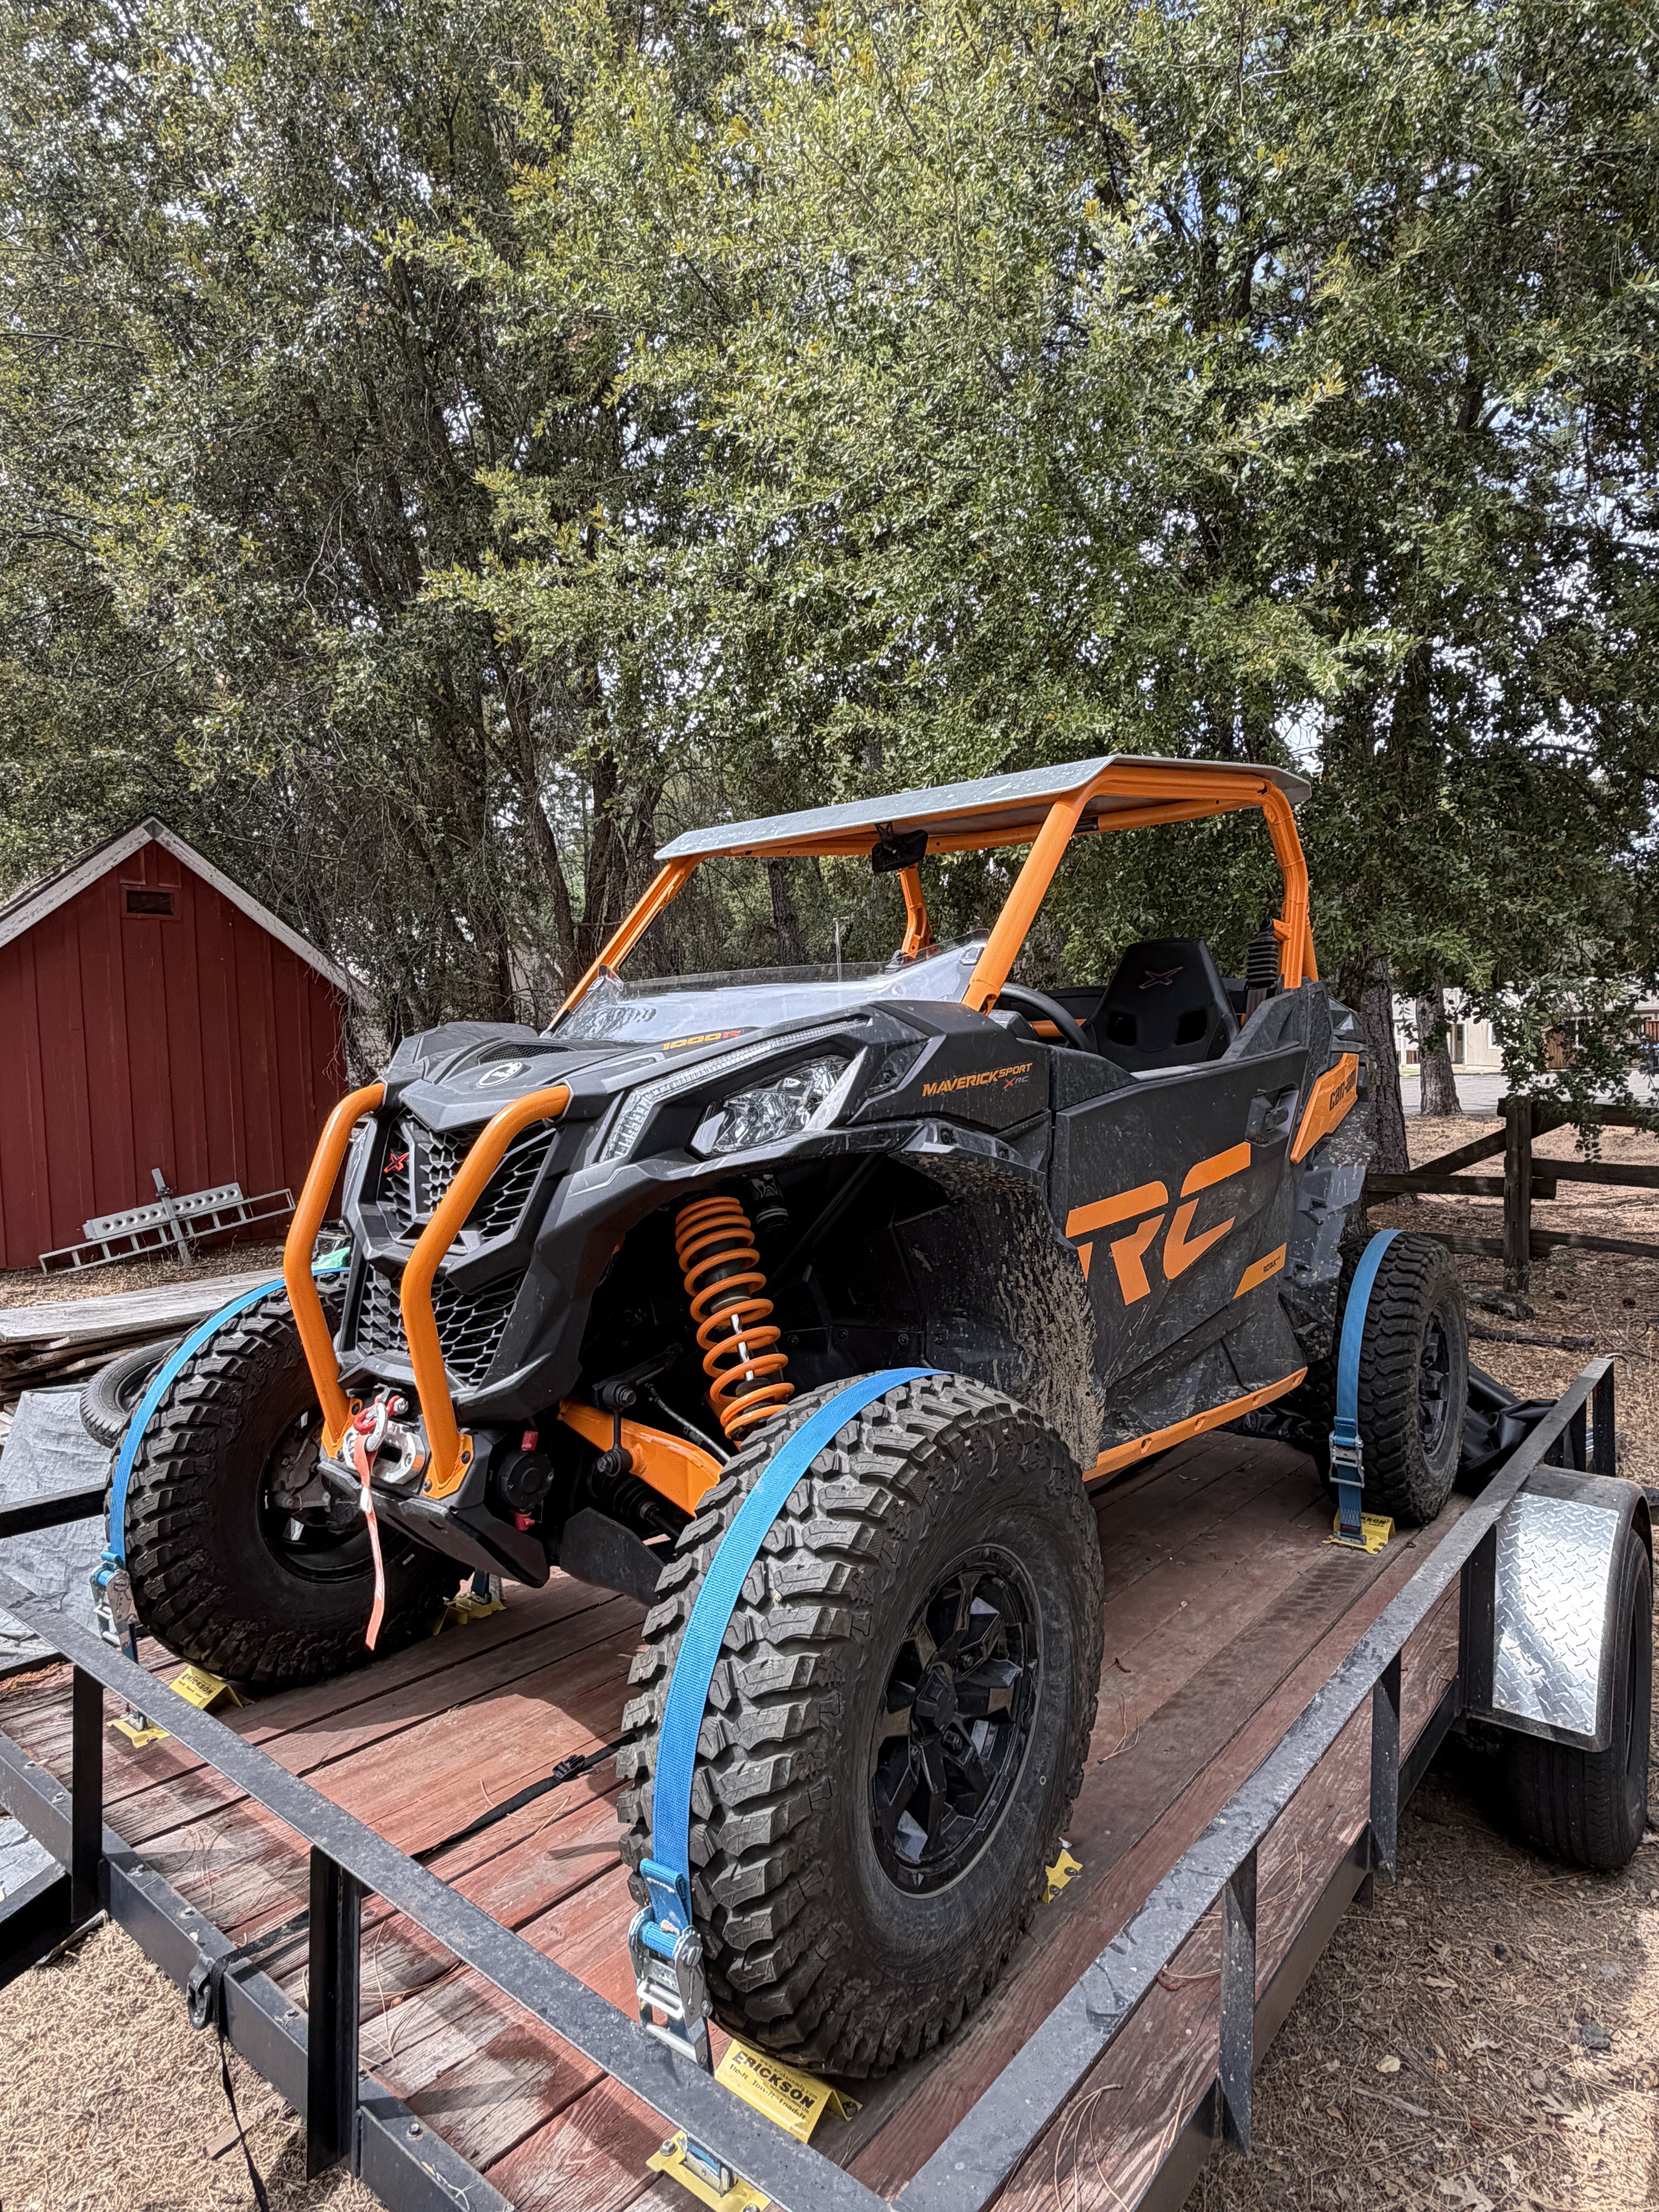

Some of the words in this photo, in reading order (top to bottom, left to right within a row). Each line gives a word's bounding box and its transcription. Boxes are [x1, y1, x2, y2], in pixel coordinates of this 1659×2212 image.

[663, 1030, 741, 1050] 1000R
[922, 1070, 998, 1097] MAVERICK
[998, 1063, 1033, 1078] SPORT
[1066, 1142, 1251, 1305] RC
[732, 2051, 815, 2109] ERICKSON
